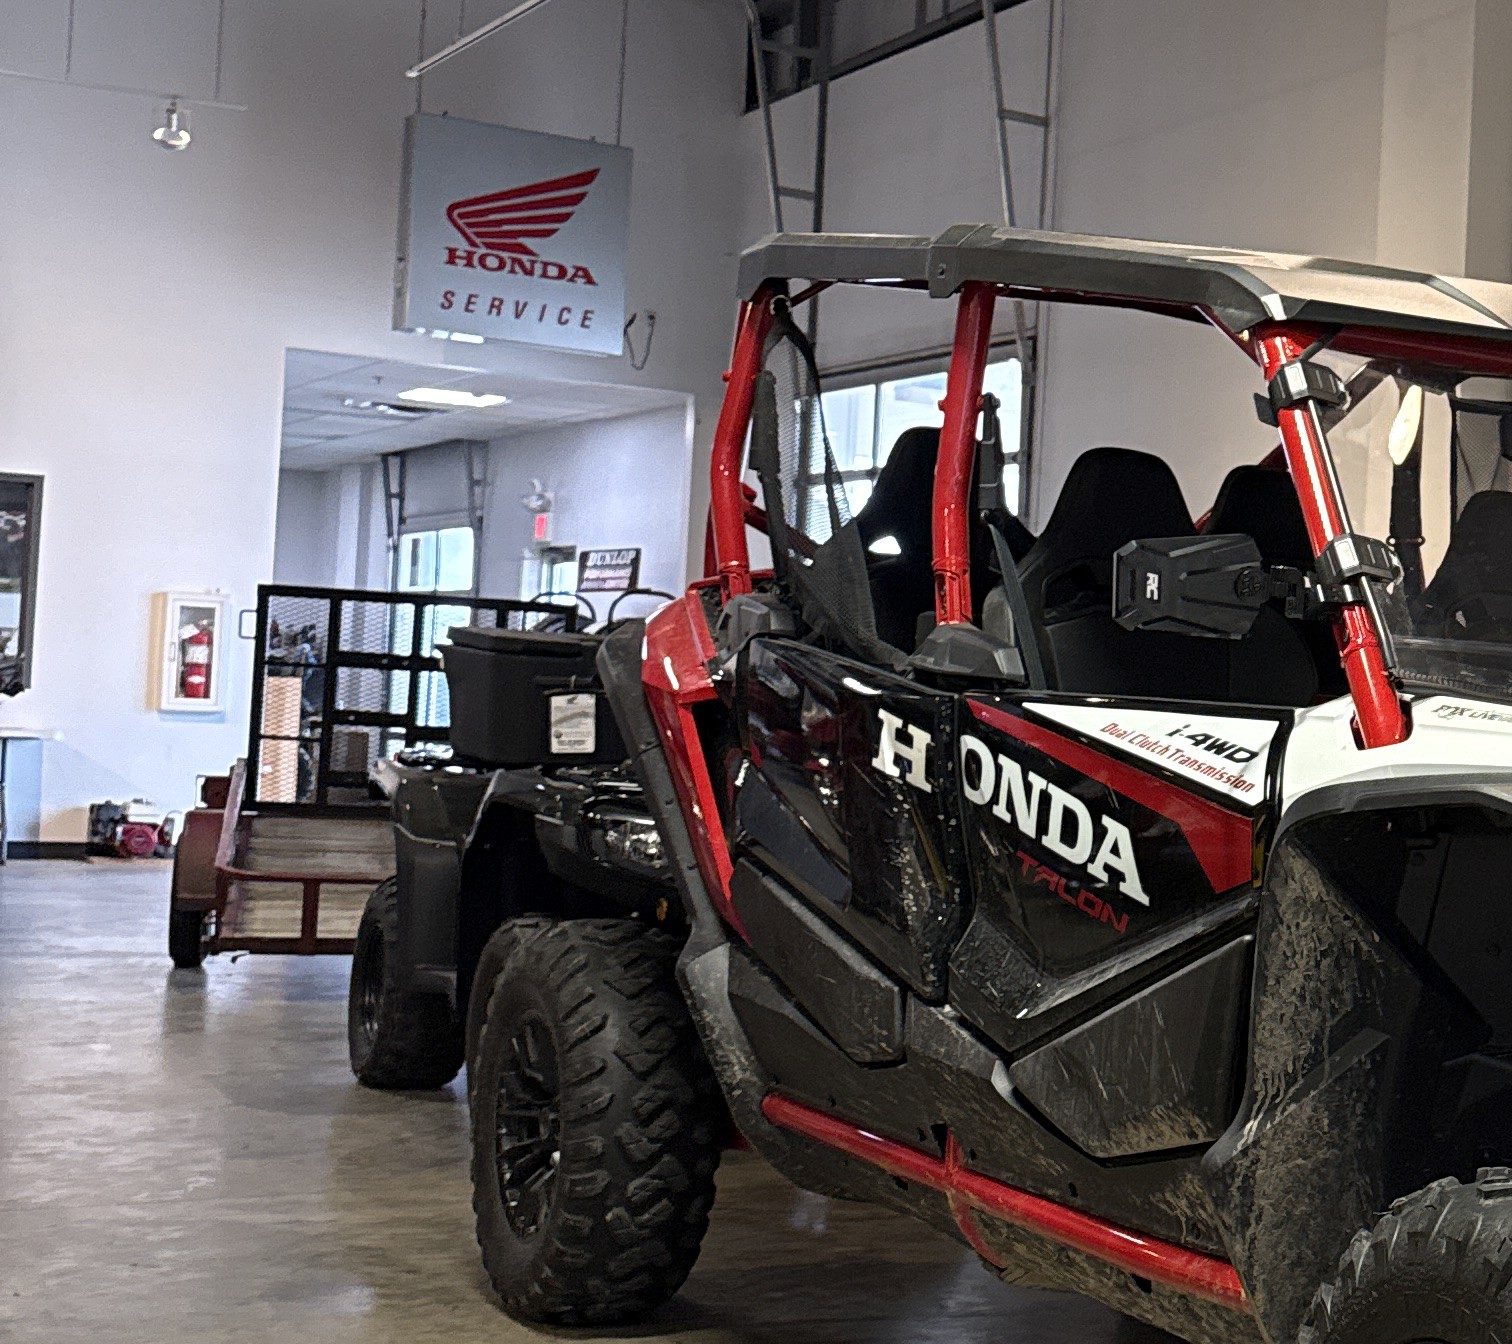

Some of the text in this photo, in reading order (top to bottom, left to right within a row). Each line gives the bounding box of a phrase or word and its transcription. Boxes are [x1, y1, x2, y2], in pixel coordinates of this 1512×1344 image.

[444, 246, 598, 286] HONDA
[440, 290, 595, 329] SERVICE
[1146, 572, 1160, 601] RC
[1100, 722, 1256, 793] Dual Clutch Transmission
[872, 707, 1150, 907] HONDA
[1016, 849, 1130, 934] TALON
